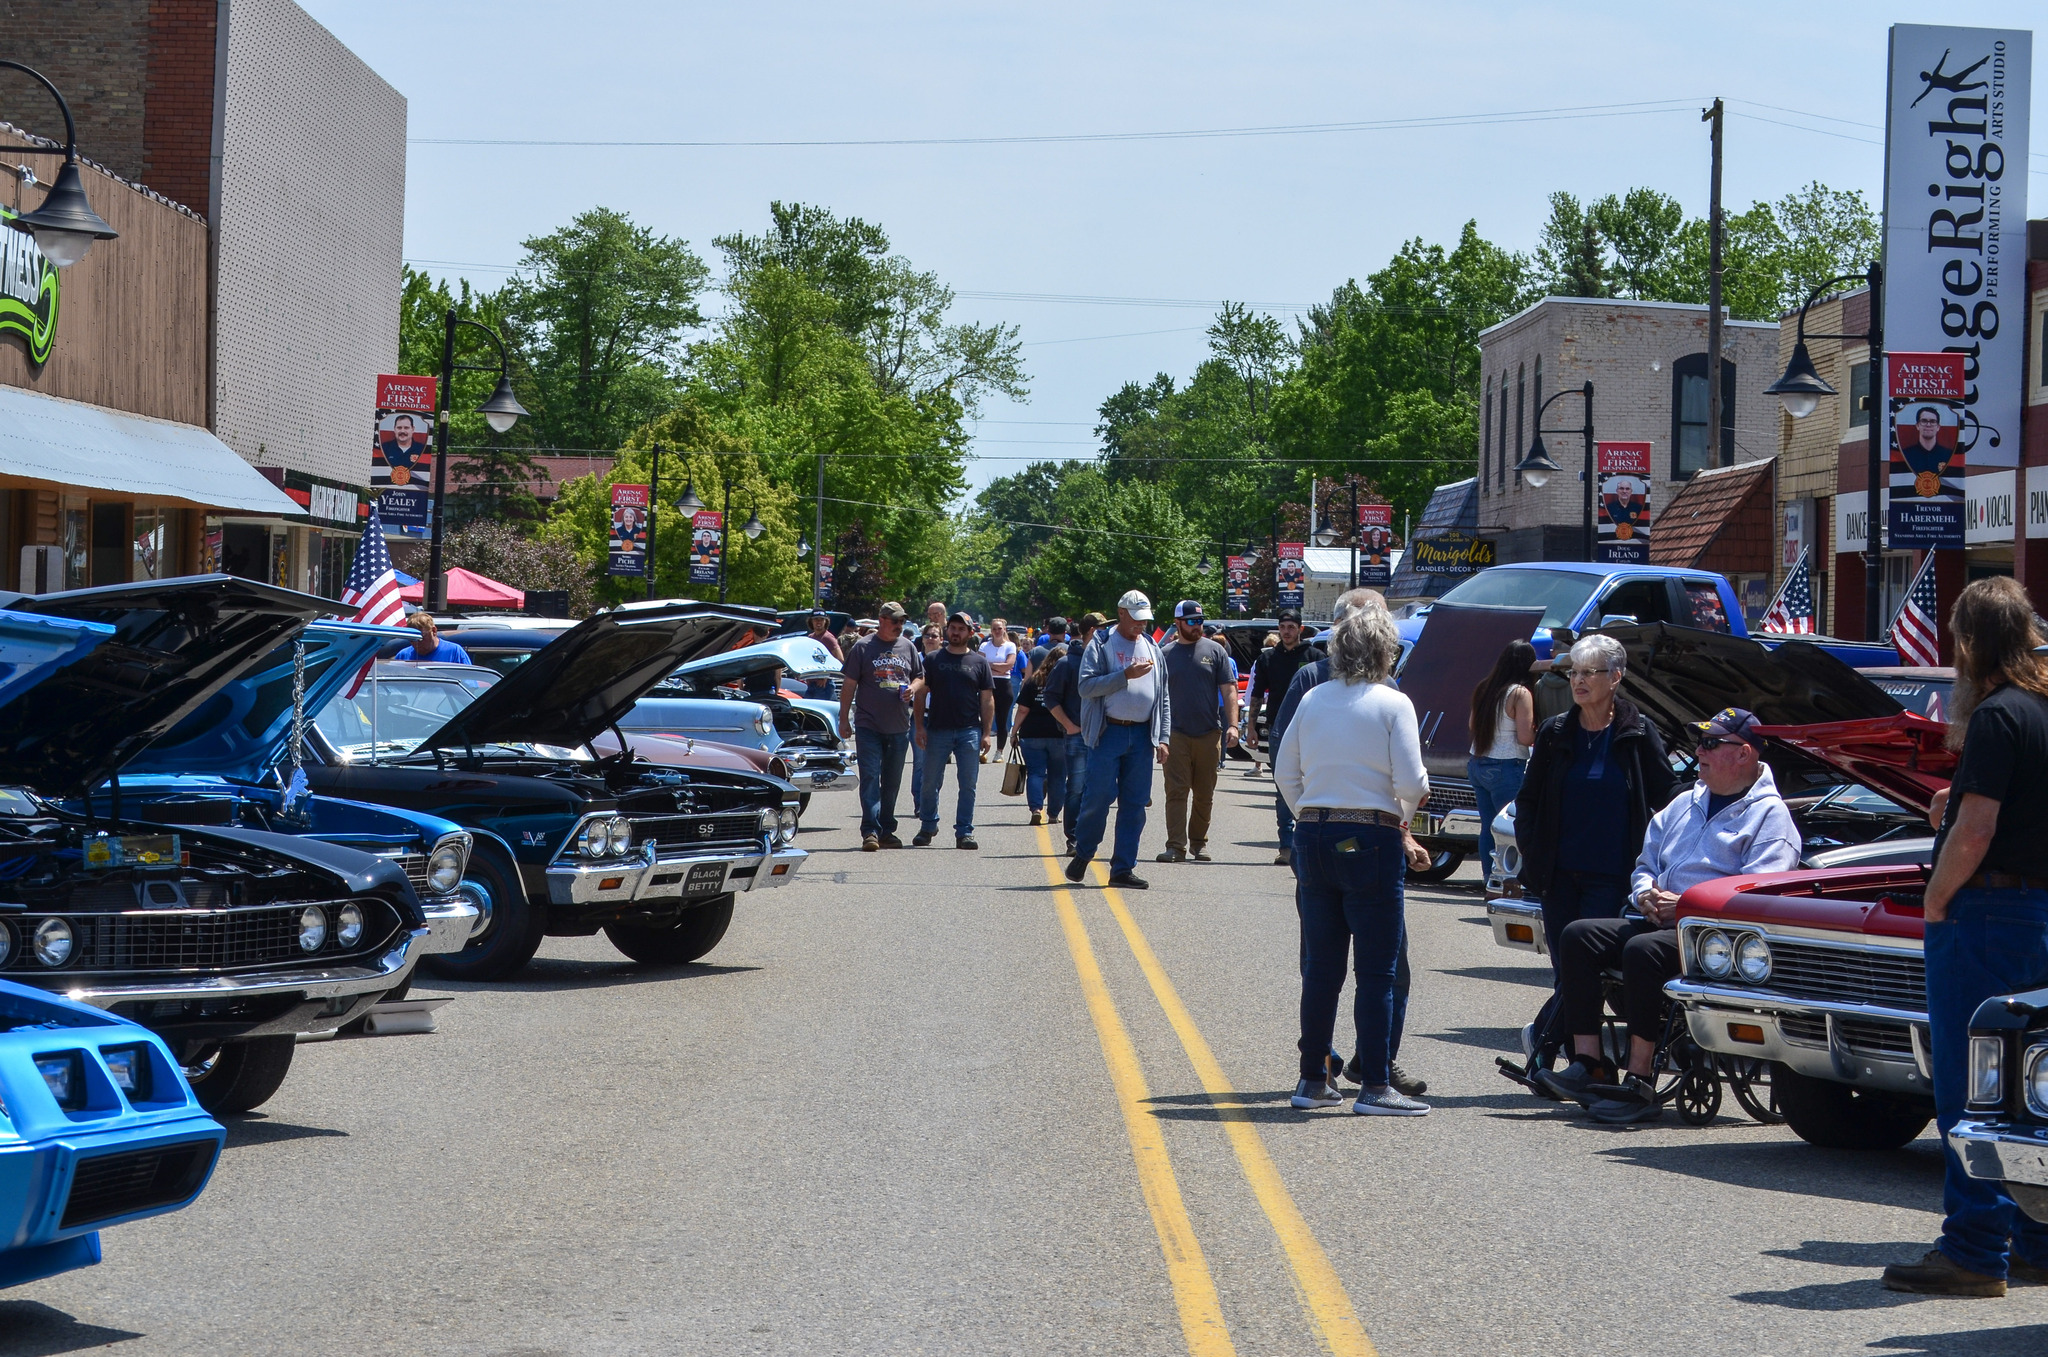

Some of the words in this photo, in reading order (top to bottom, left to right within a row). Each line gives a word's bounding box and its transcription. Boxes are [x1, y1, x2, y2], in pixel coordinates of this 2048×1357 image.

[1993, 40, 2006, 98] STUDIO
[1991, 101, 2004, 139] ARTS
[1986, 186, 2001, 298] PERFORMING
[1899, 363, 1953, 374] ARENAC
[385, 382, 428, 393] ARENAC
[1903, 378, 1949, 389] FIRST
[1896, 388, 1958, 396] RESPONDERS
[387, 394, 424, 404] FIRST
[381, 401, 431, 410] RESPONDERS
[1605, 449, 1642, 457] ARENAC
[1608, 459, 1640, 467] FIRST
[381, 495, 417, 507] YEALEY
[1915, 504, 1942, 512] TREVOR
[1986, 494, 2013, 528] VOCAL
[1900, 512, 1957, 523] HABERMEHL
[1846, 511, 1867, 540] DANCE
[1417, 540, 1493, 566] Marigolds
[1608, 549, 1640, 559] IRLAND
[699, 824, 714, 834] SS
[692, 870, 721, 879] BLACK
[688, 881, 721, 891] BETTY
